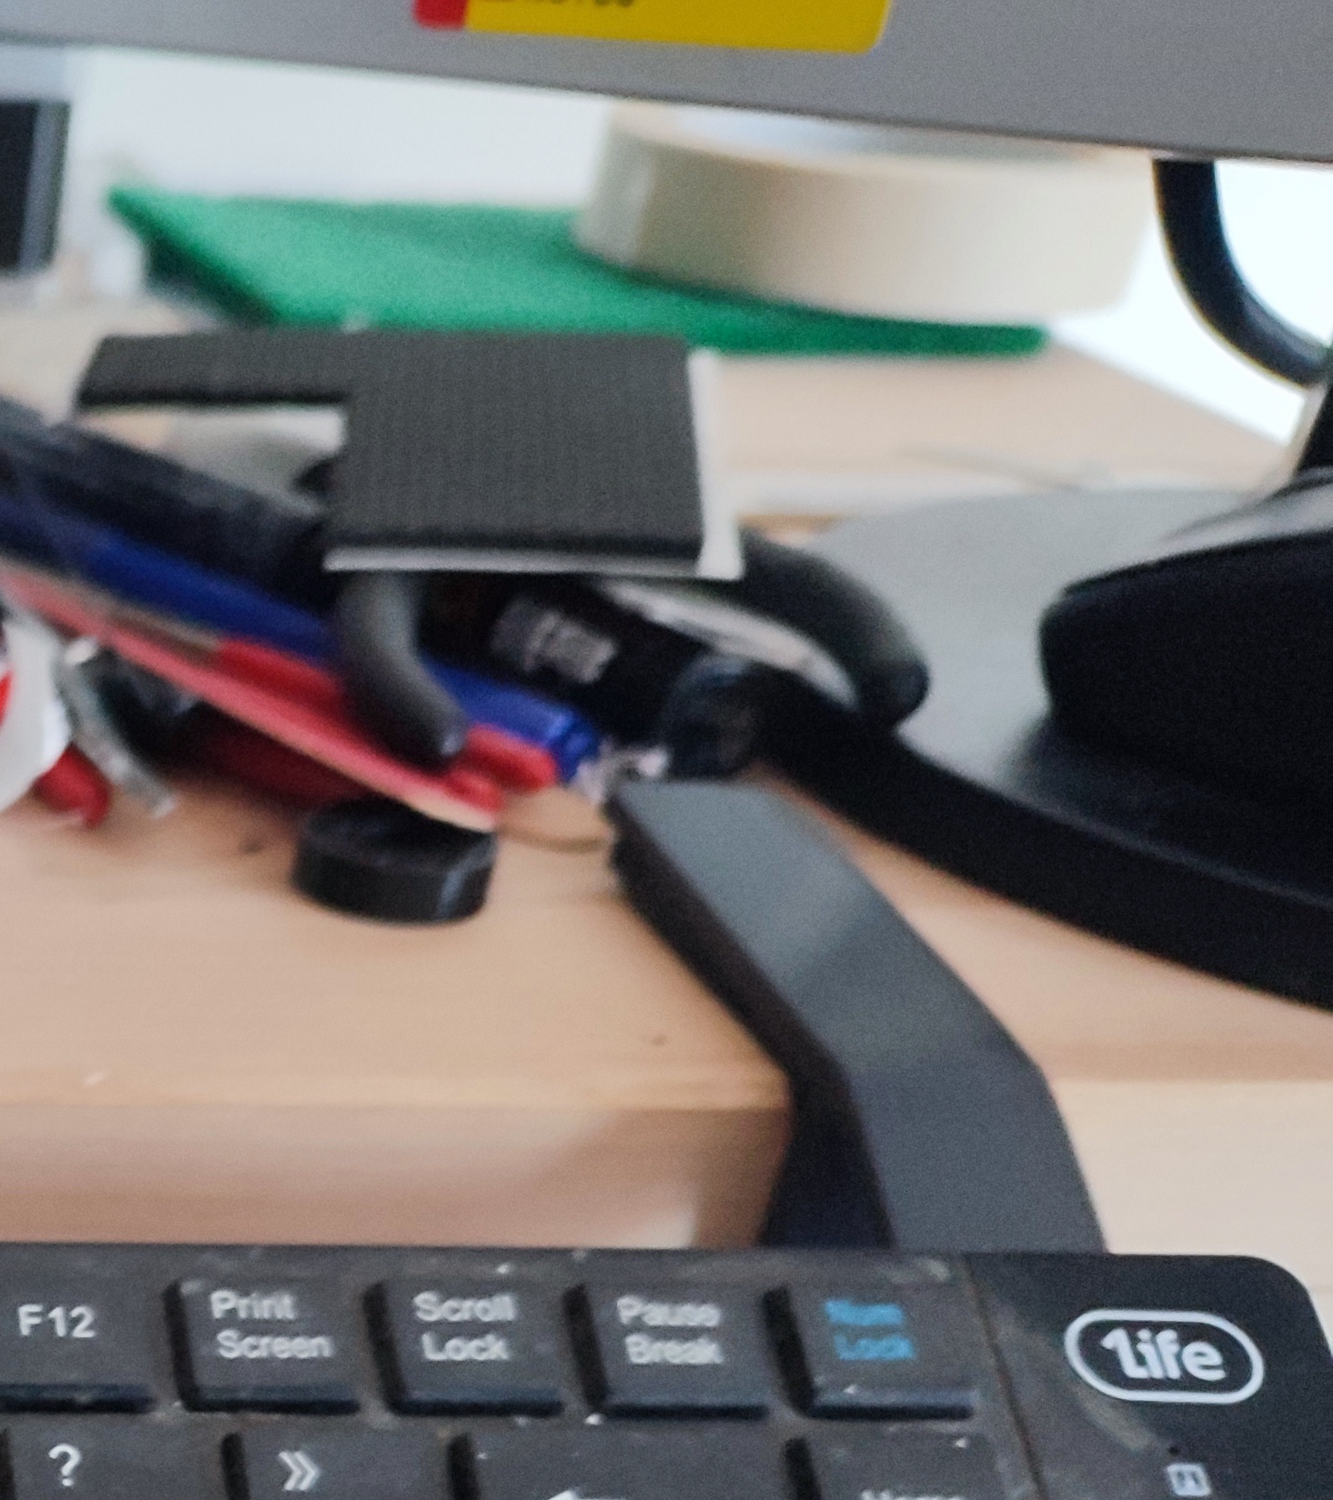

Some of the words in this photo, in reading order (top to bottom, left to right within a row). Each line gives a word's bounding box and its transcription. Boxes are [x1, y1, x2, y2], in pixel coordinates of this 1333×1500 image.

[16, 1302, 97, 1340] F12
[208, 1288, 299, 1321] Print
[412, 1290, 519, 1324] Scroll
[615, 1294, 723, 1329] Pause
[215, 1327, 334, 1361] Screen
[420, 1331, 511, 1363] Lock
[47, 1442, 83, 1488] ?
